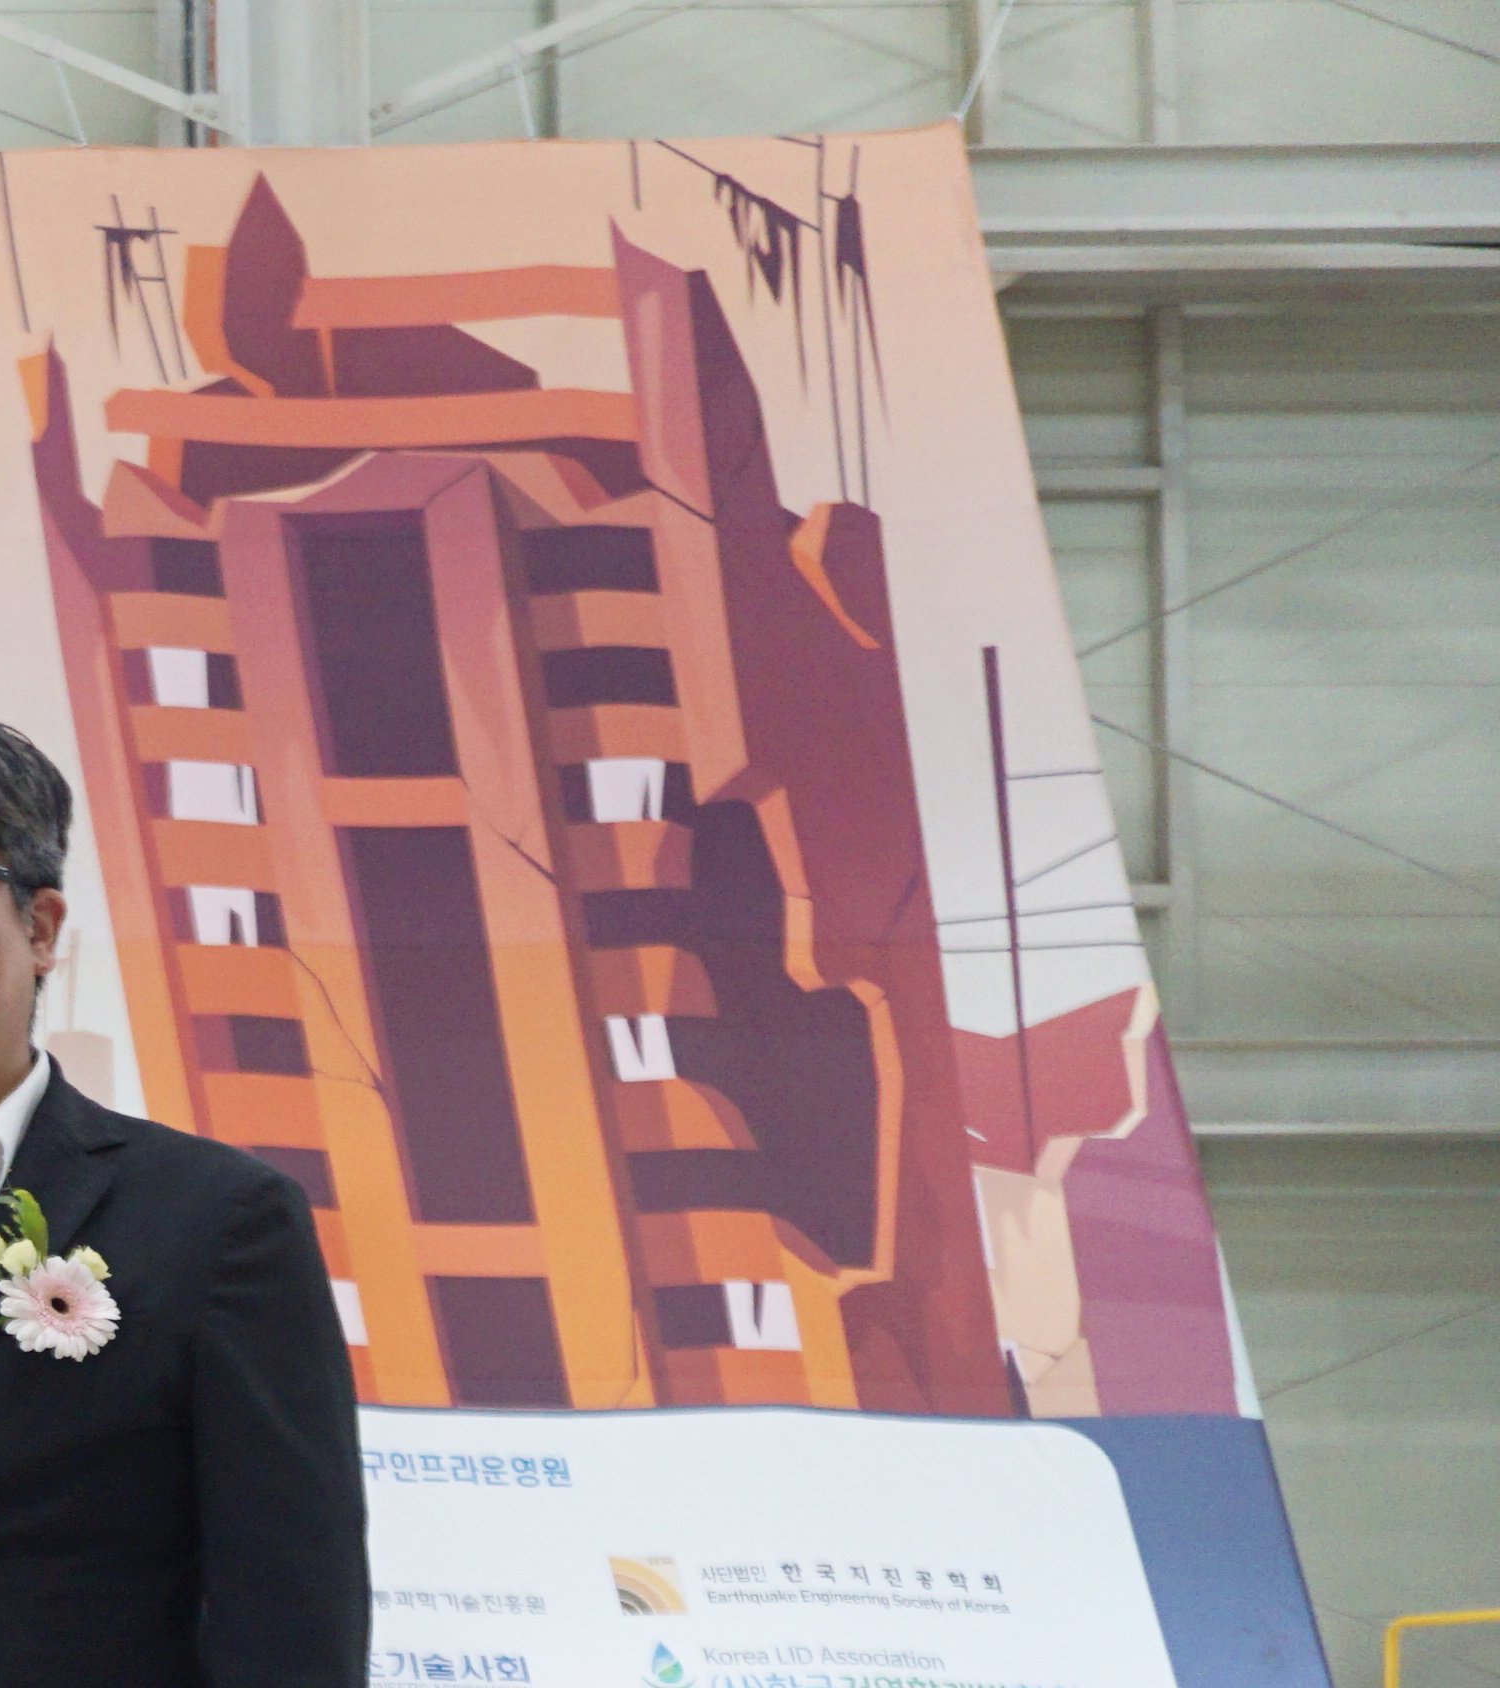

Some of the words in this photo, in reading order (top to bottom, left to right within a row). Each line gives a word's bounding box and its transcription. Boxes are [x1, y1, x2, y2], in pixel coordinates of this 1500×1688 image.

[701, 1565, 768, 1584] 사단법인
[707, 1589, 797, 1606] Earthquake
[801, 1590, 889, 1609] Engineering
[892, 1594, 944, 1612] Society
[947, 1598, 962, 1612] of
[964, 1600, 1011, 1615] Korea
[703, 1646, 768, 1667] Korea
[776, 1646, 813, 1666] LID
[821, 1647, 945, 1672] Association
